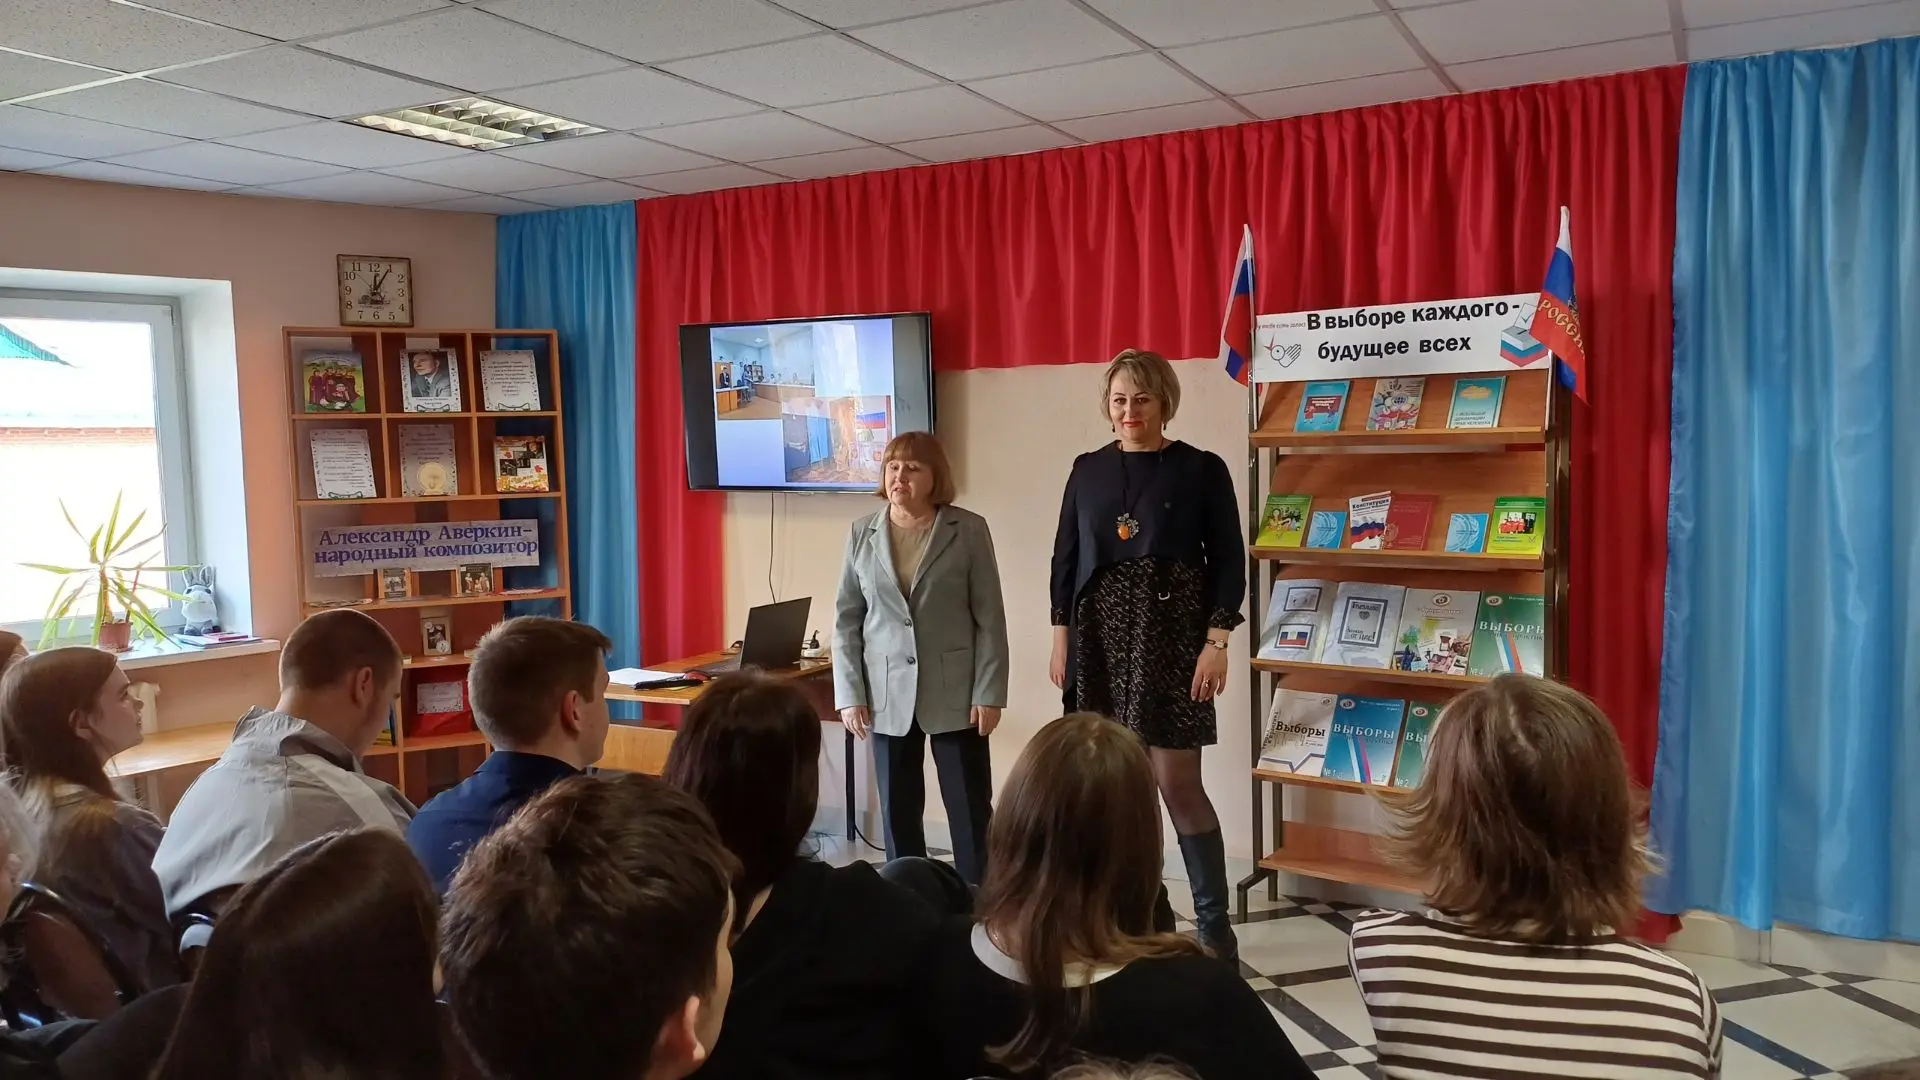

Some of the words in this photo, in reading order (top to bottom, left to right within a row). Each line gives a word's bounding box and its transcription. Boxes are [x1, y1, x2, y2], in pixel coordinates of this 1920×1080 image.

[352, 262, 362, 272] 11
[368, 262, 380, 273] 12
[344, 271, 356, 281] 10
[397, 273, 405, 283] 2
[344, 285, 352, 296] 9
[397, 288, 405, 298] 3
[346, 300, 353, 310] 8
[398, 303, 405, 312] 4
[357, 310, 364, 319] 7
[372, 311, 380, 320] 6
[388, 312, 395, 321] 5
[1307, 313, 1321, 331] В
[1324, 309, 1406, 330] выборе
[1412, 301, 1509, 322] каждого
[1317, 340, 1410, 363] будущее
[1419, 336, 1472, 353] всех
[319, 527, 431, 546] Александр
[438, 525, 533, 542] Аверкин-
[314, 543, 417, 566] народный
[423, 540, 539, 559] композитор
[1275, 720, 1326, 737] Выборы
[1333, 723, 1395, 739] ВЫБОРЫ
